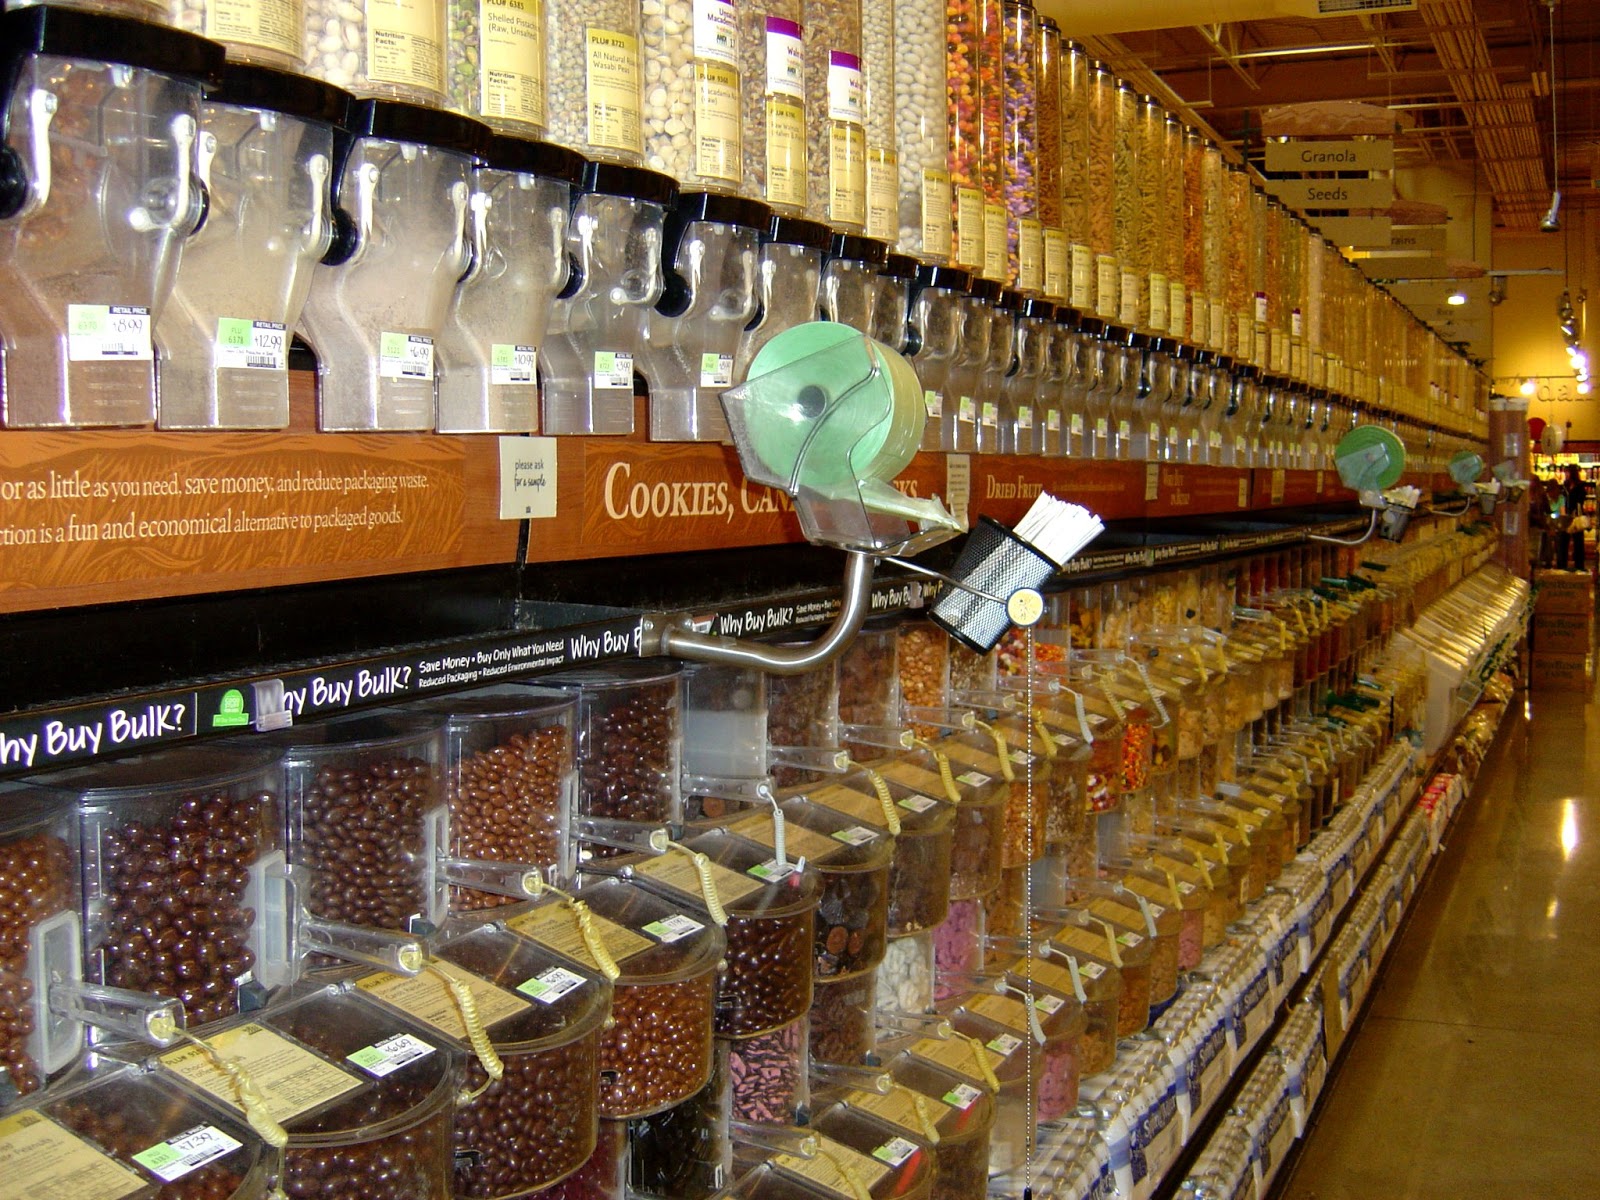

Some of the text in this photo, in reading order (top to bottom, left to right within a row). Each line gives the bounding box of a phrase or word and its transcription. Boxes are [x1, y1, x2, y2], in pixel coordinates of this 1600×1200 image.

[375, 31, 405, 39] Nutrition
[1301, 150, 1357, 163] Granola
[1308, 187, 1348, 200] Seeds
[515, 459, 544, 470] please ask
[1, 470, 429, 502] or as little as you need, save money, and reduce packaging waste.
[528, 474, 546, 492] sample
[39, 523, 52, 543] is
[55, 527, 66, 543] a
[68, 514, 99, 542] fun
[102, 512, 136, 539] and
[139, 506, 232, 537] economical
[234, 511, 299, 534] alternative
[300, 514, 312, 530] to
[314, 508, 367, 532] packaged
[368, 507, 403, 530] goods.
[872, 591, 888, 609] Why
[720, 614, 743, 635] Why
[745, 610, 765, 630] Buy
[419, 638, 565, 674] Save Money Buy Only What You Need
[570, 633, 601, 661] Why
[603, 629, 629, 654] Buy
[418, 655, 564, 688] Reduced Packaging Reduced Environmental Impact
[311, 675, 352, 706] Buy
[0, 732, 38, 767] hy
[46, 720, 102, 754] Buy
